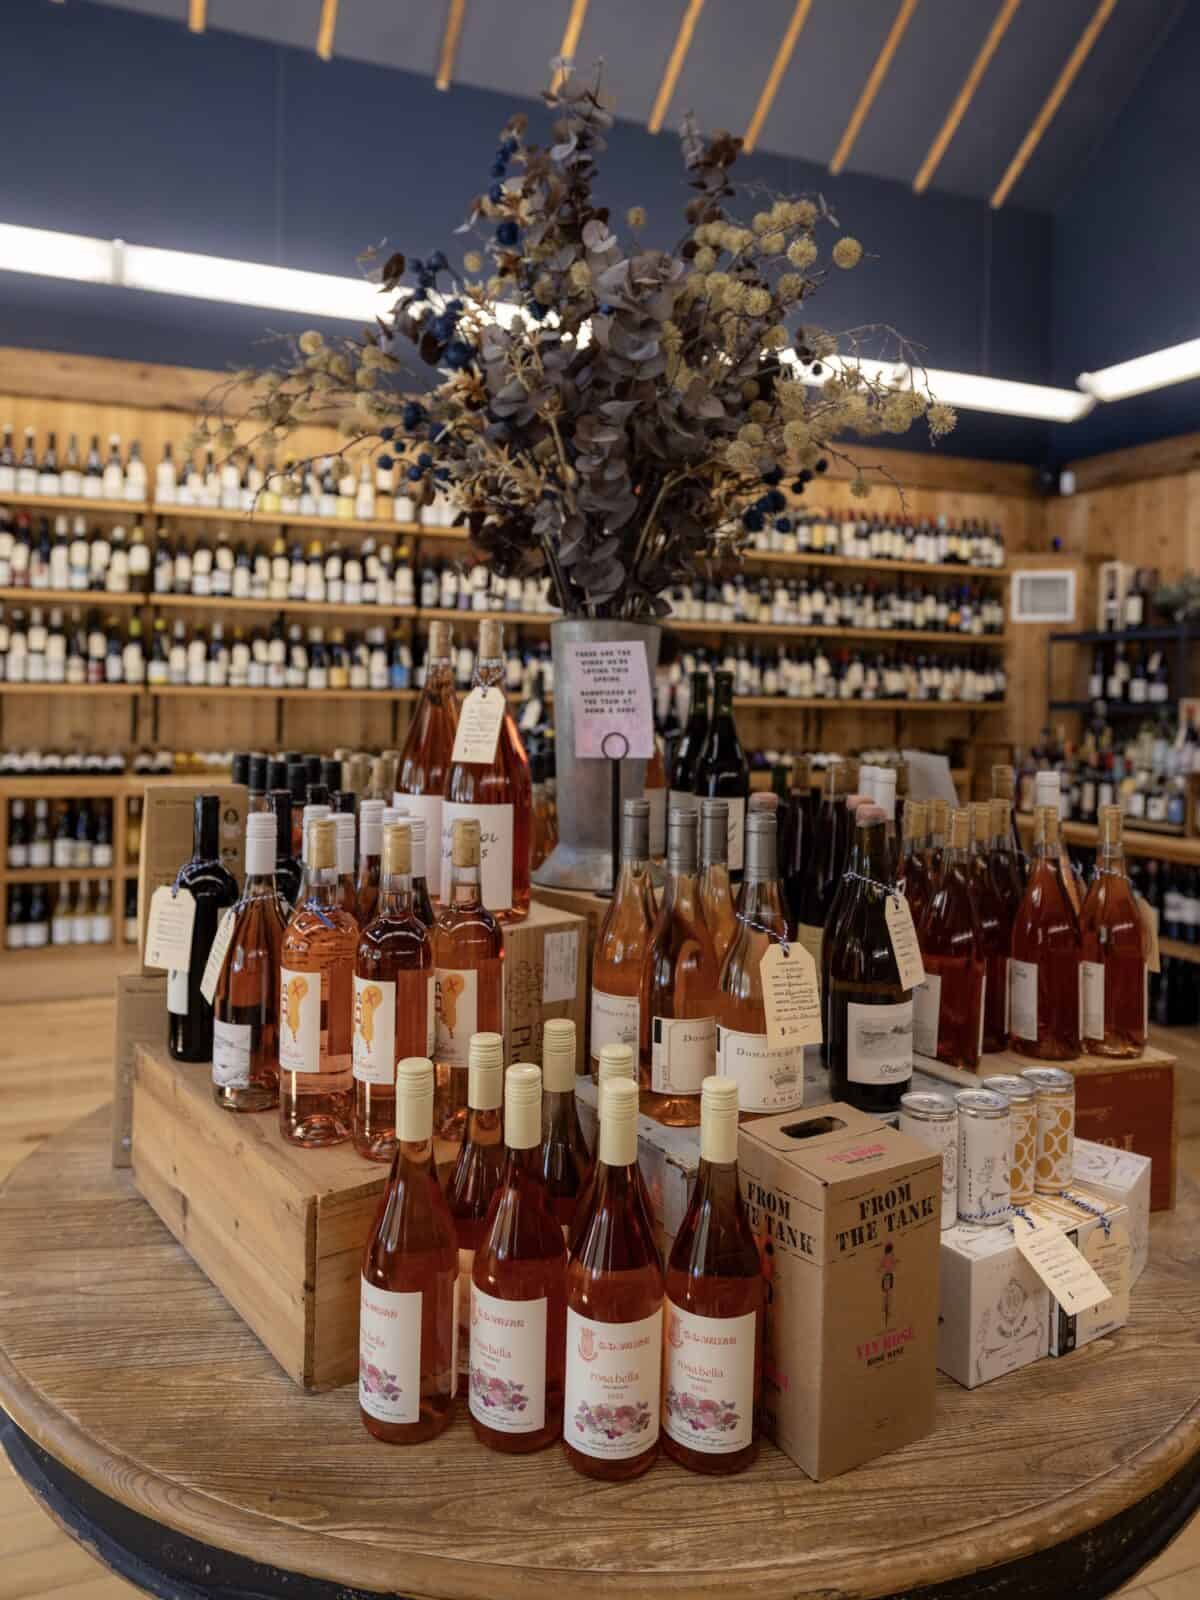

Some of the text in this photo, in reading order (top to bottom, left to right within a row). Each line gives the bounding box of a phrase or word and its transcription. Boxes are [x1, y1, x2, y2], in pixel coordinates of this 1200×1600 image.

[748, 1183, 791, 1220] FROM
[859, 1182, 912, 1221] FROM
[765, 1213, 816, 1255] TANK
[835, 1195, 937, 1253] THE TANK
